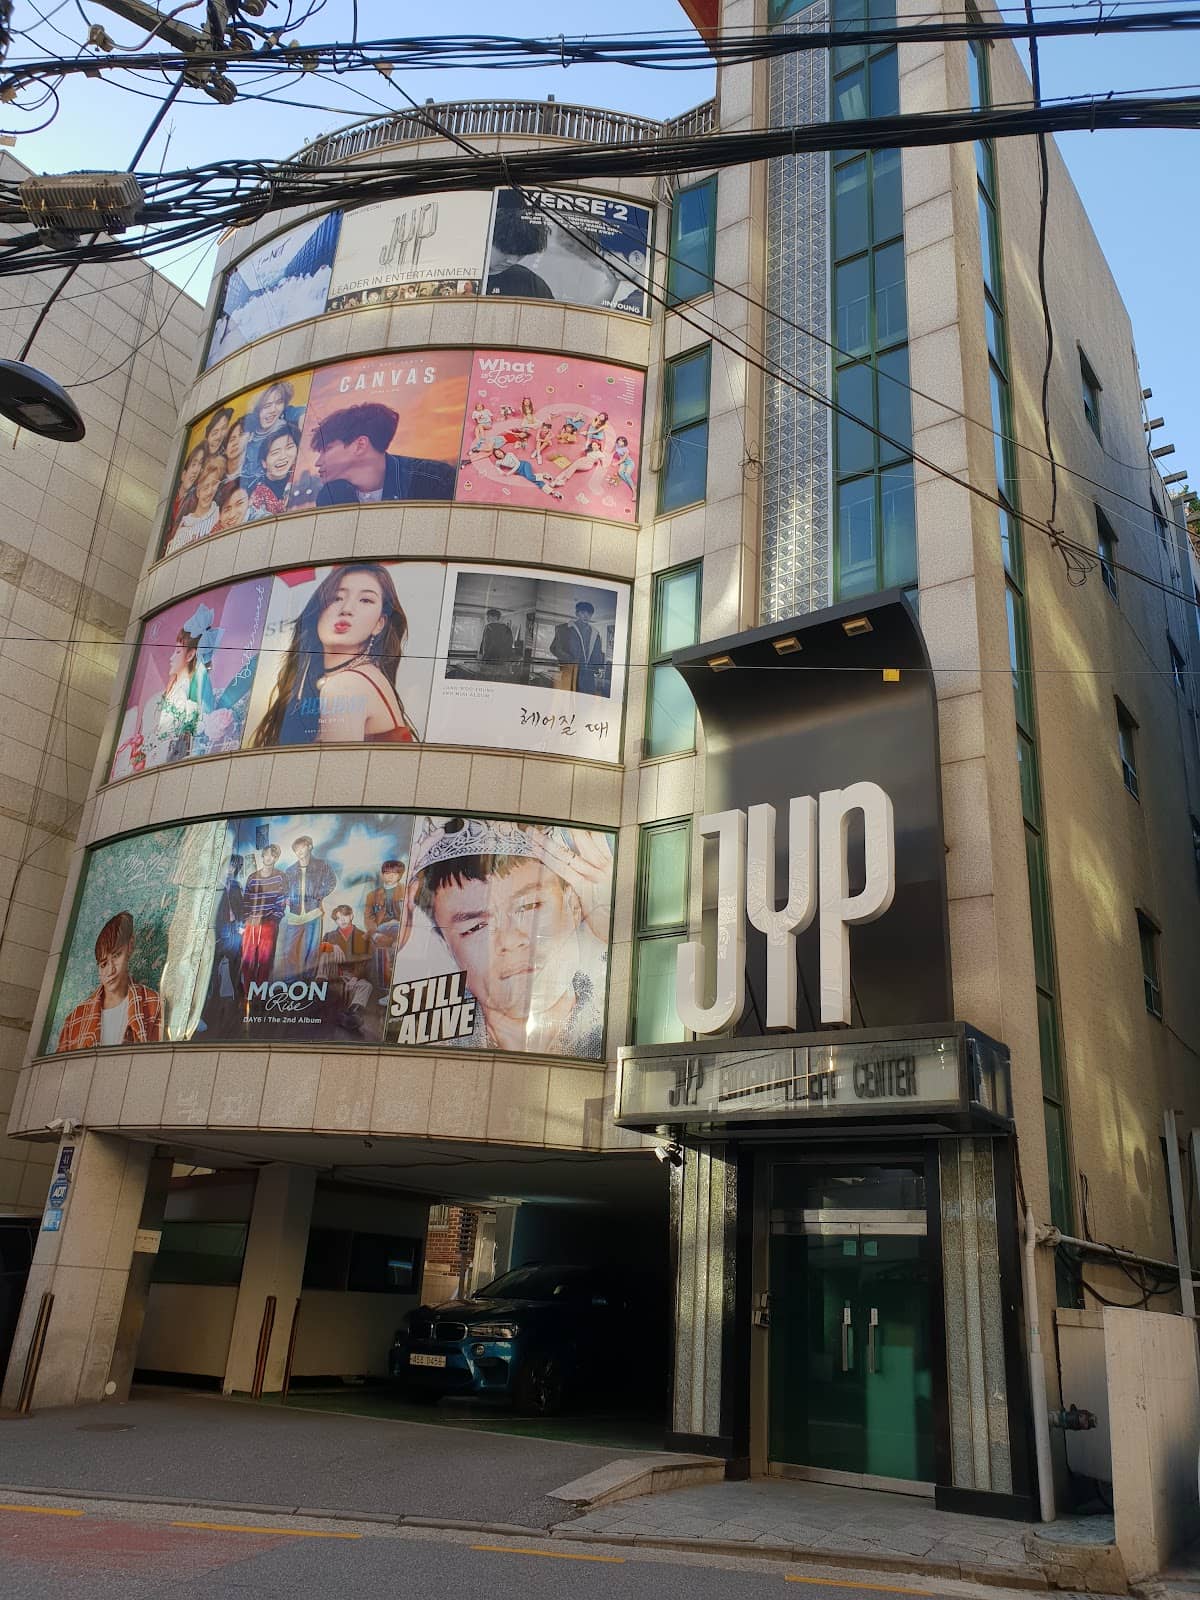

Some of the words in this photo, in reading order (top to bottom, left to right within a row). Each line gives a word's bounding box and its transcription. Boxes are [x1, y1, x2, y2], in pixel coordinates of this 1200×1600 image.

[522, 191, 628, 221] VERSE'2
[379, 200, 439, 265] JYP
[332, 278, 369, 295] LEADER
[371, 275, 383, 285] IN
[385, 267, 478, 283] ENTERTAINMENT
[600, 300, 641, 314] JINYOUNG
[339, 366, 437, 393] CANVAS
[479, 358, 535, 373] What
[519, 707, 577, 736] 헤어질
[585, 721, 609, 739] 때
[675, 781, 895, 1034] JYP
[247, 981, 328, 1001] MOON
[265, 993, 314, 1012] Rise
[391, 973, 462, 1017] STILL
[298, 1016, 322, 1024] Album
[397, 1003, 476, 1044] ALIVE
[669, 1058, 705, 1107] JYP
[853, 1055, 918, 1099] CENTER
